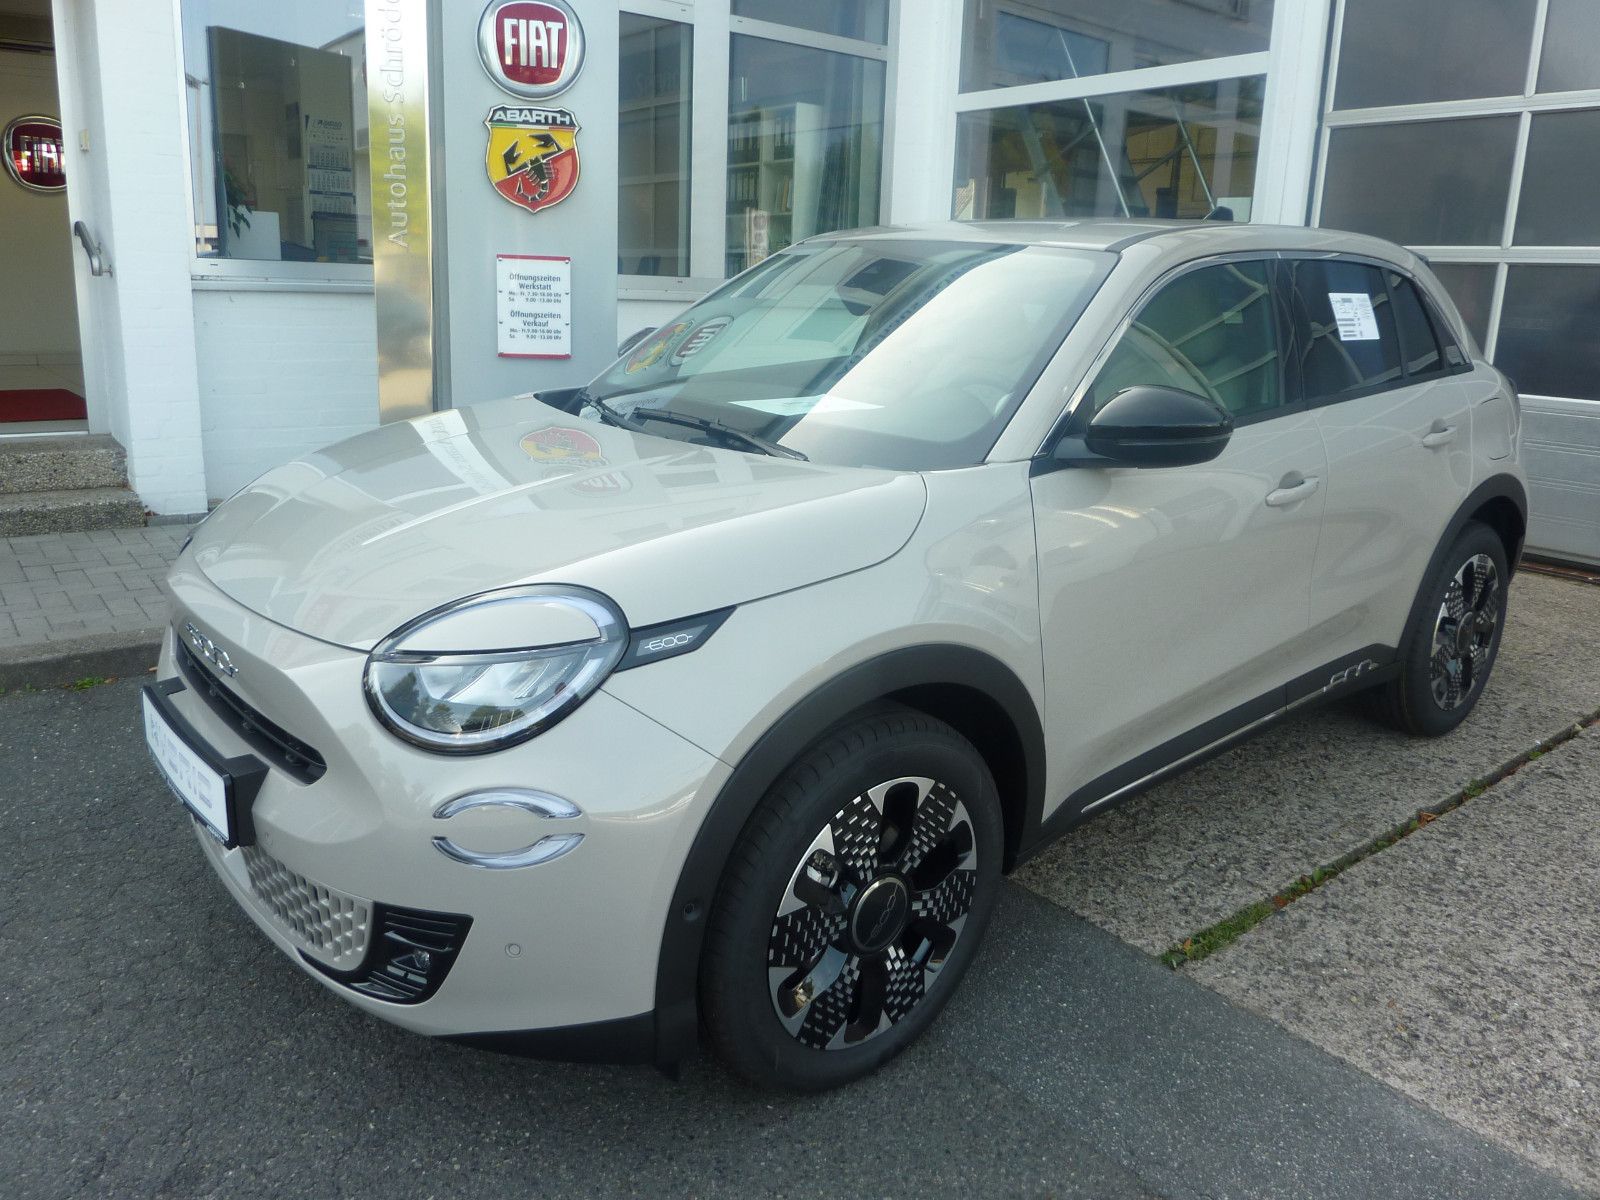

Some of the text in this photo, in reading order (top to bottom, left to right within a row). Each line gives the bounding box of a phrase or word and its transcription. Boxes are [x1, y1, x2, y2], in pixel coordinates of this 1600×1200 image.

[503, 18, 563, 69] FIAT
[492, 109, 570, 125] ABARTH
[378, 0, 409, 248] Autohaus Schröd
[509, 273, 561, 283] Öffnungszeiten
[518, 282, 552, 290] Werkstatt
[510, 310, 561, 319] Öffnungszeiten
[522, 319, 549, 327] Verkauf
[648, 633, 689, 651] 600
